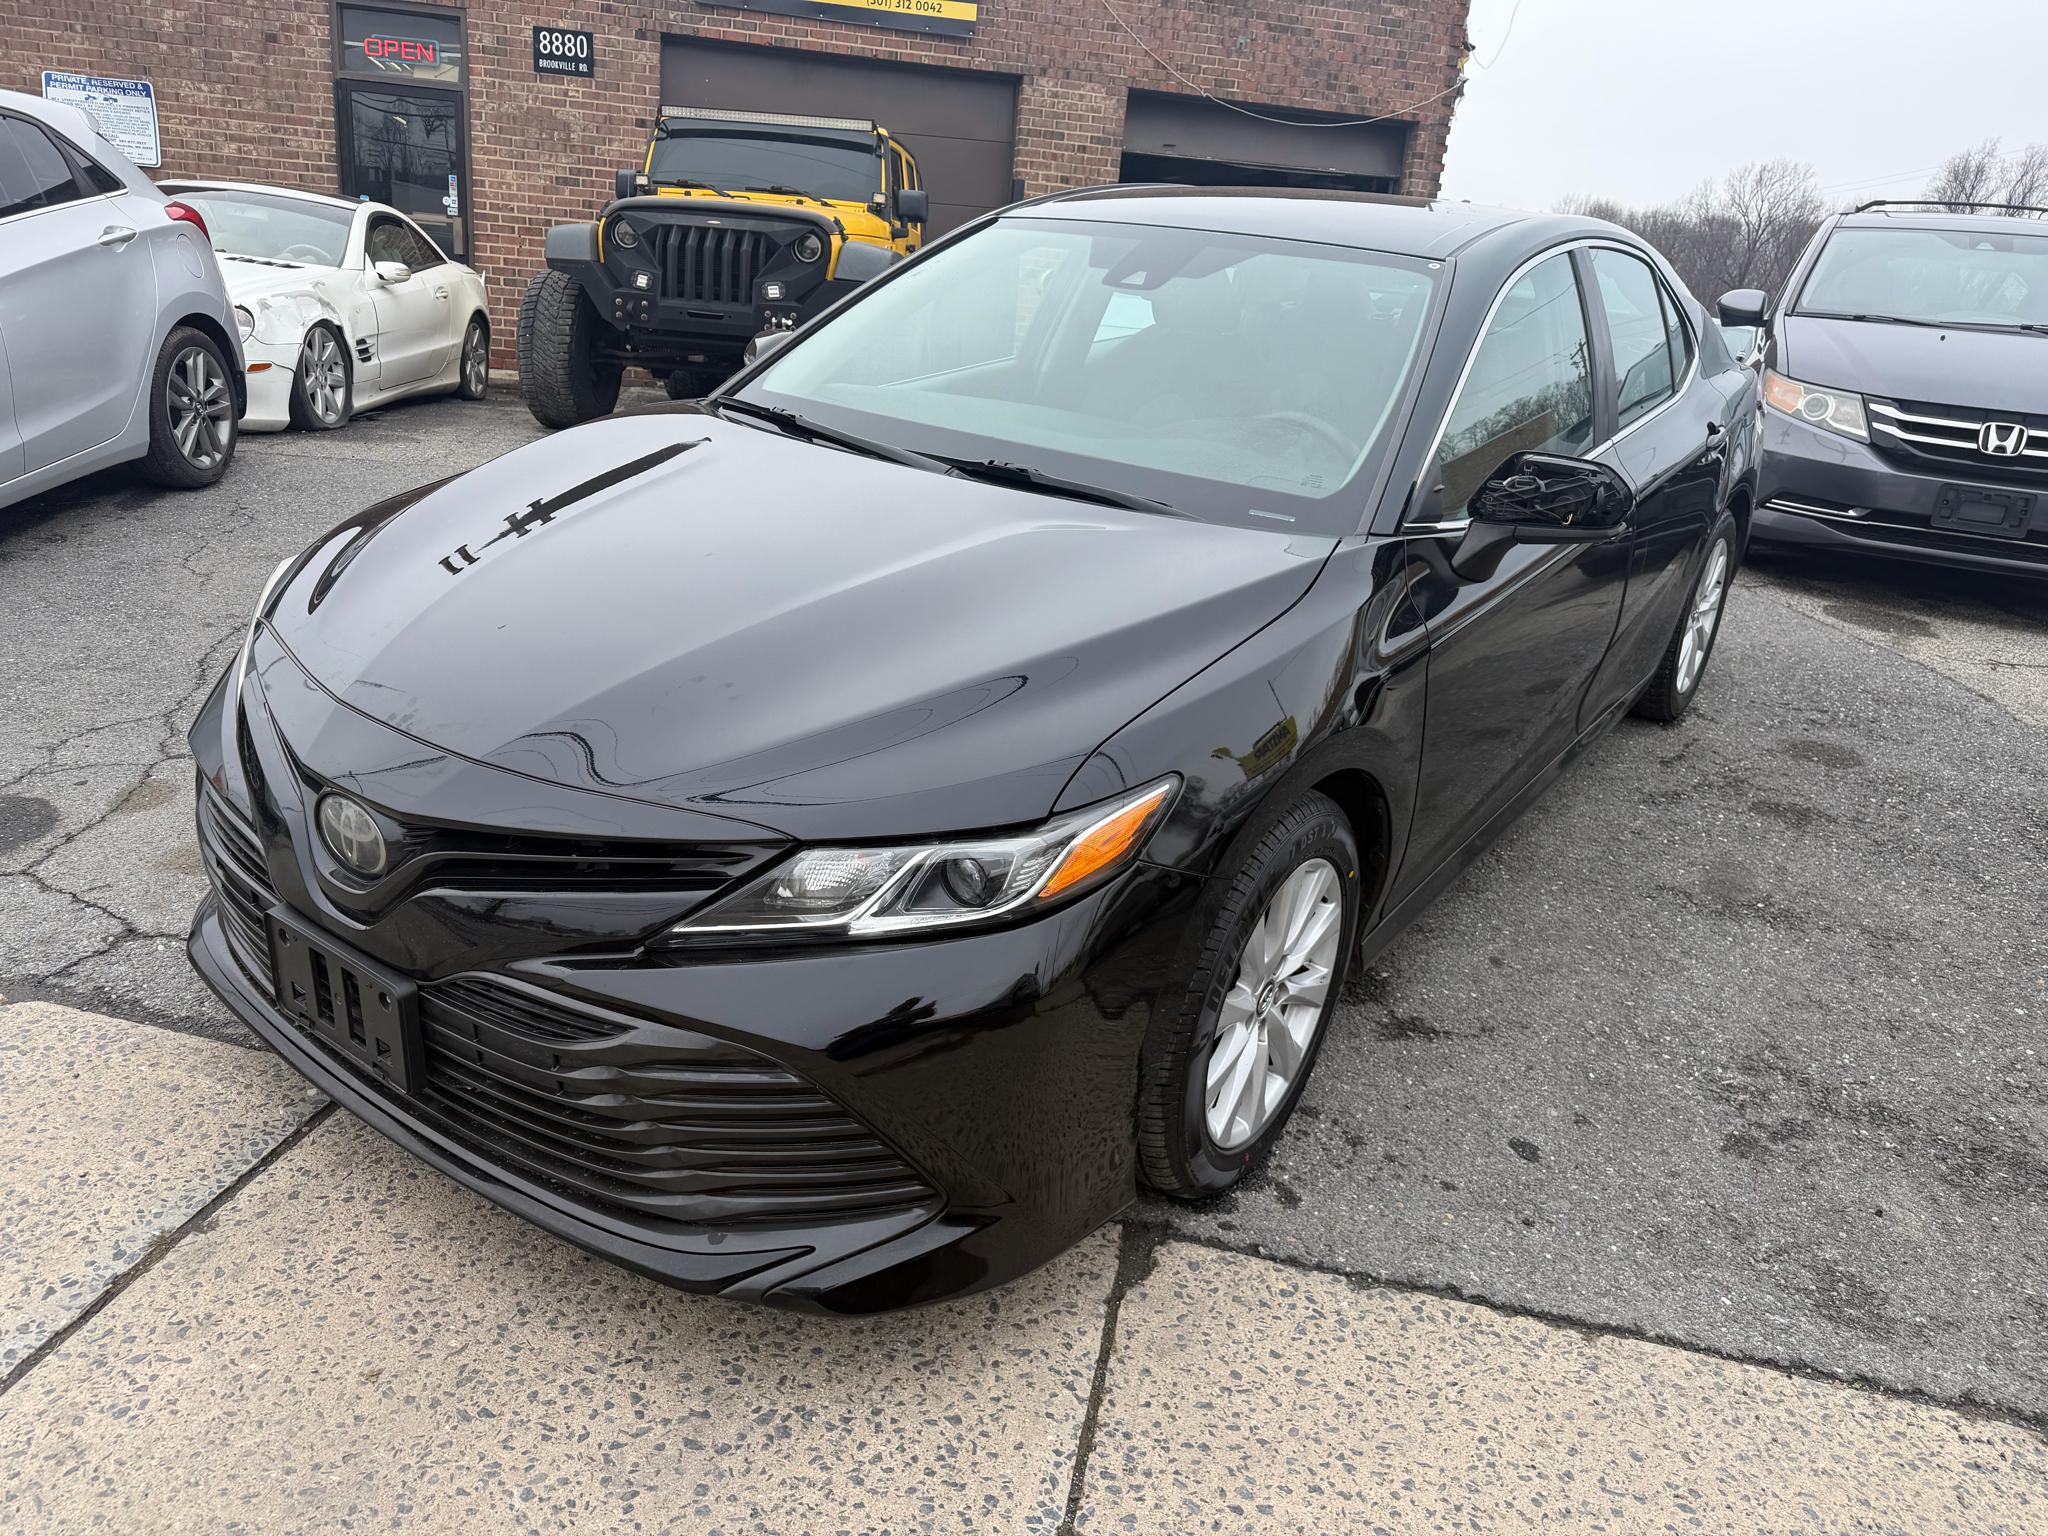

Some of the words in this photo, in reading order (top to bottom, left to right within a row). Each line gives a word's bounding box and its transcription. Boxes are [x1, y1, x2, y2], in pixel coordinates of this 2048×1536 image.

[895, 0, 912, 10] 312
[915, 0, 943, 13] 0042
[364, 38, 435, 63] OPEN
[539, 31, 587, 58] 8880
[538, 58, 576, 71] BROOKVILLE
[578, 63, 589, 72] RD.
[49, 81, 84, 91] PERMIT
[86, 85, 124, 95] PARKING
[124, 89, 147, 97] ONLY
[51, 73, 90, 86] PRIVATE,
[91, 79, 137, 89] RESERVED
